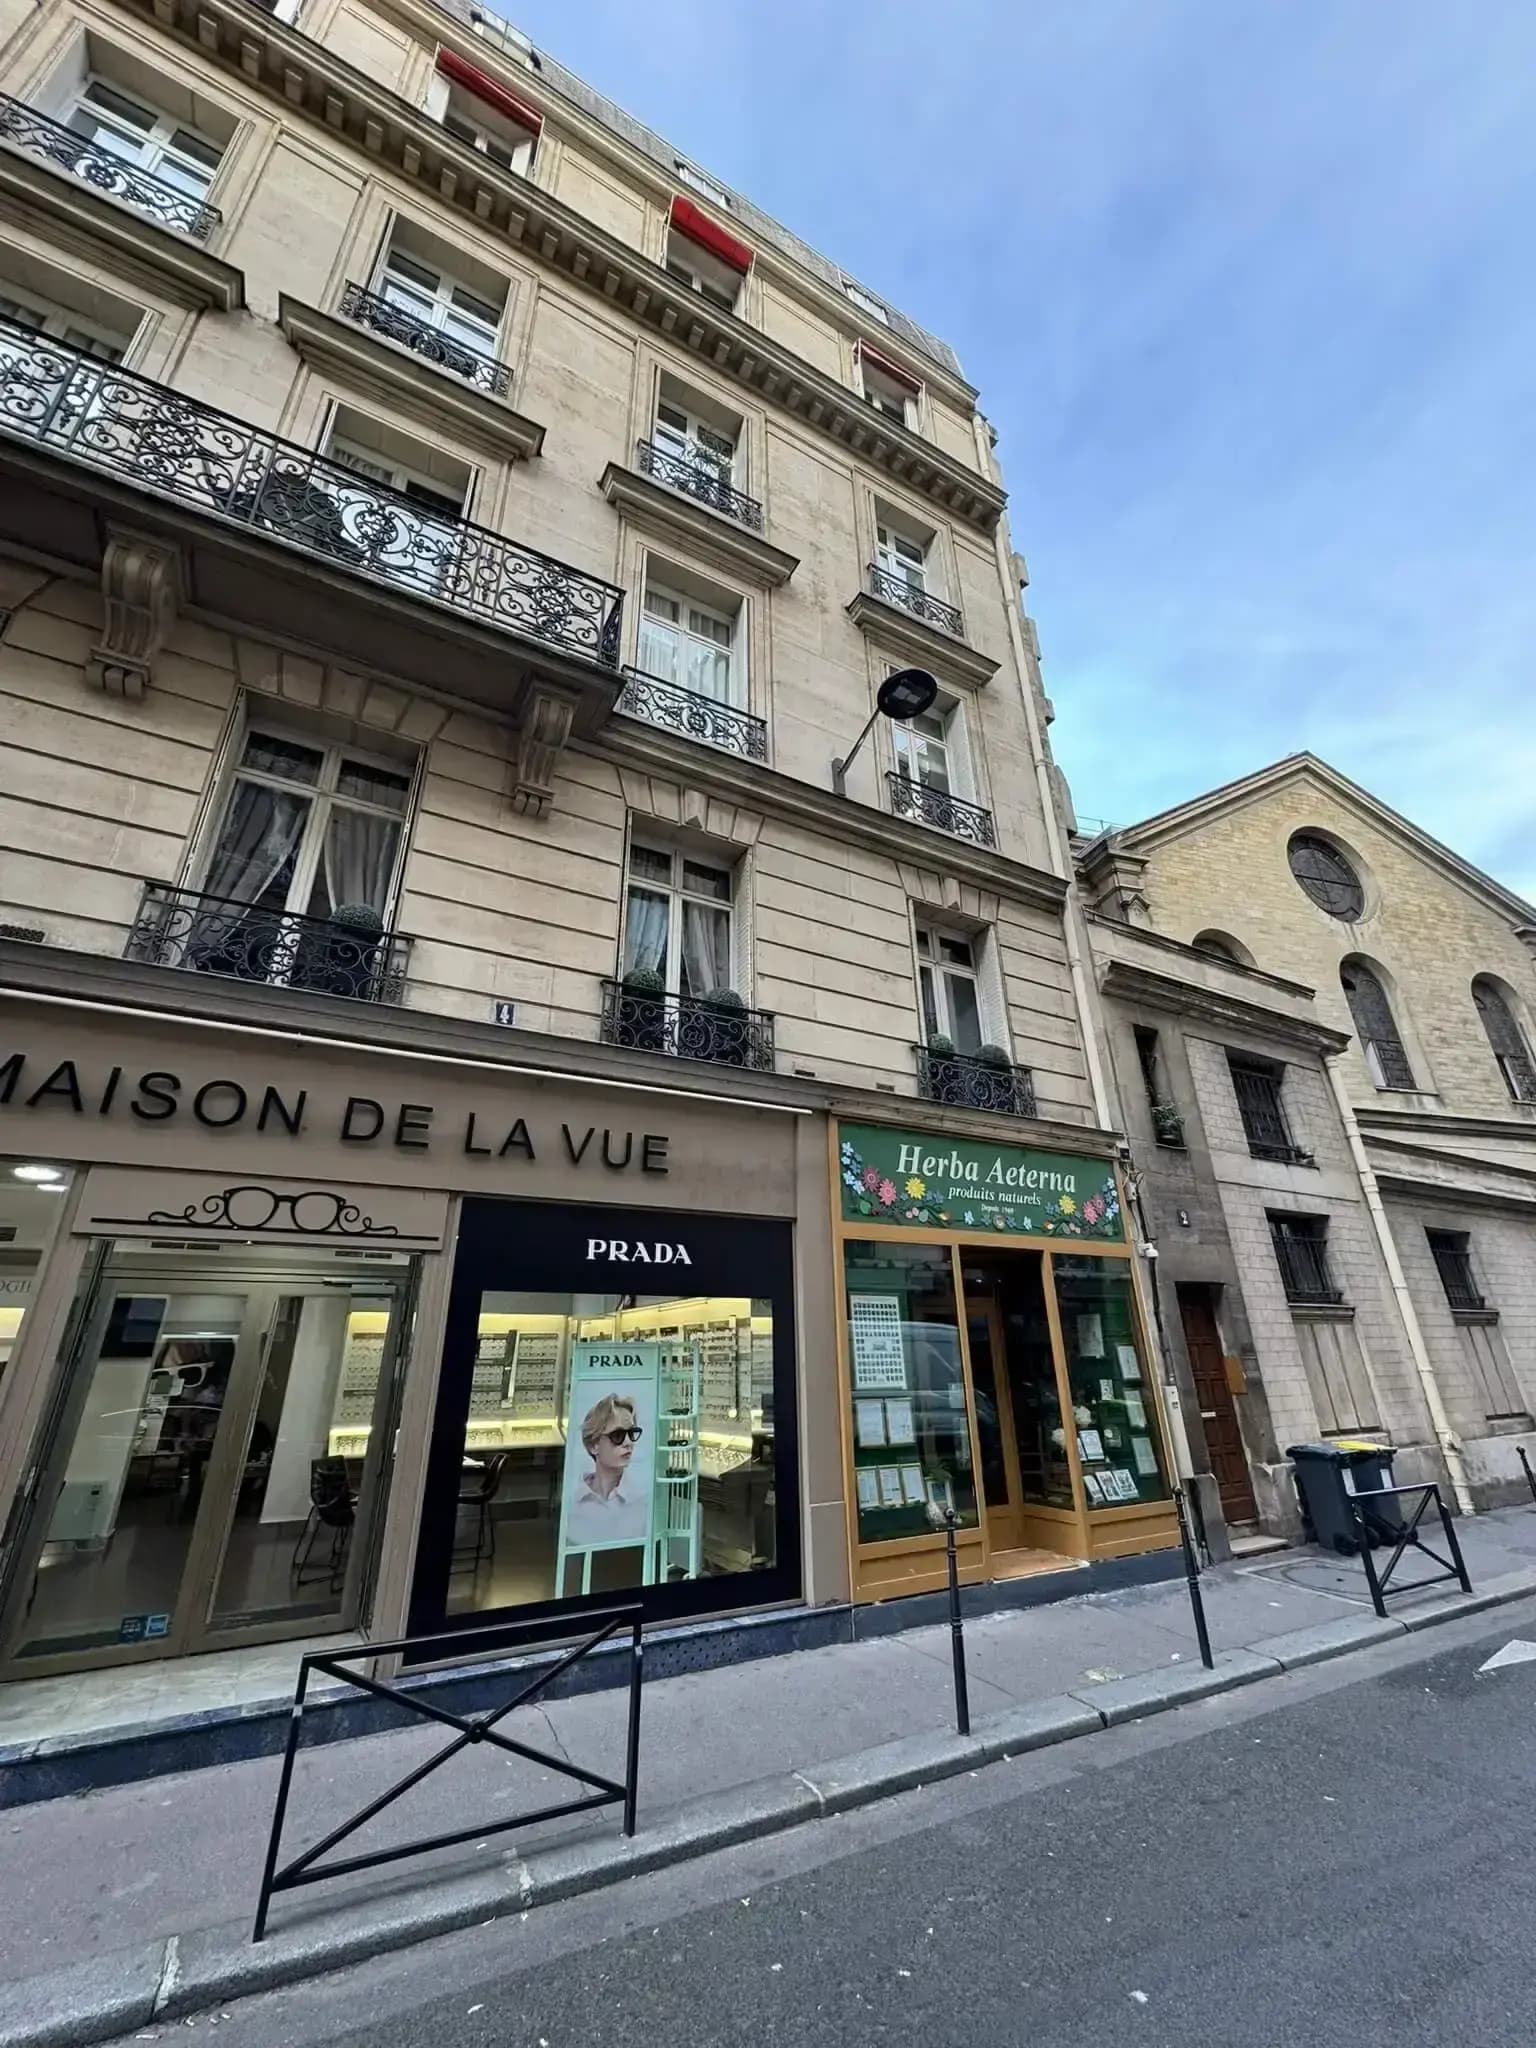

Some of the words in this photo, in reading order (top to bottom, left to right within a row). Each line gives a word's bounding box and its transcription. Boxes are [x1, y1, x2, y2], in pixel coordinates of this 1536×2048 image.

[500, 1004, 510, 1024] 4
[341, 1097, 434, 1148] DE
[464, 1112, 536, 1160] LA
[561, 1123, 669, 1174] VUE
[896, 1143, 980, 1182] Herba
[985, 1156, 1077, 1194] Aeterna
[947, 1186, 996, 1201] produits
[998, 1191, 1042, 1206] naturels
[586, 1238, 693, 1265] PRADA
[589, 1354, 644, 1368] PRADA
